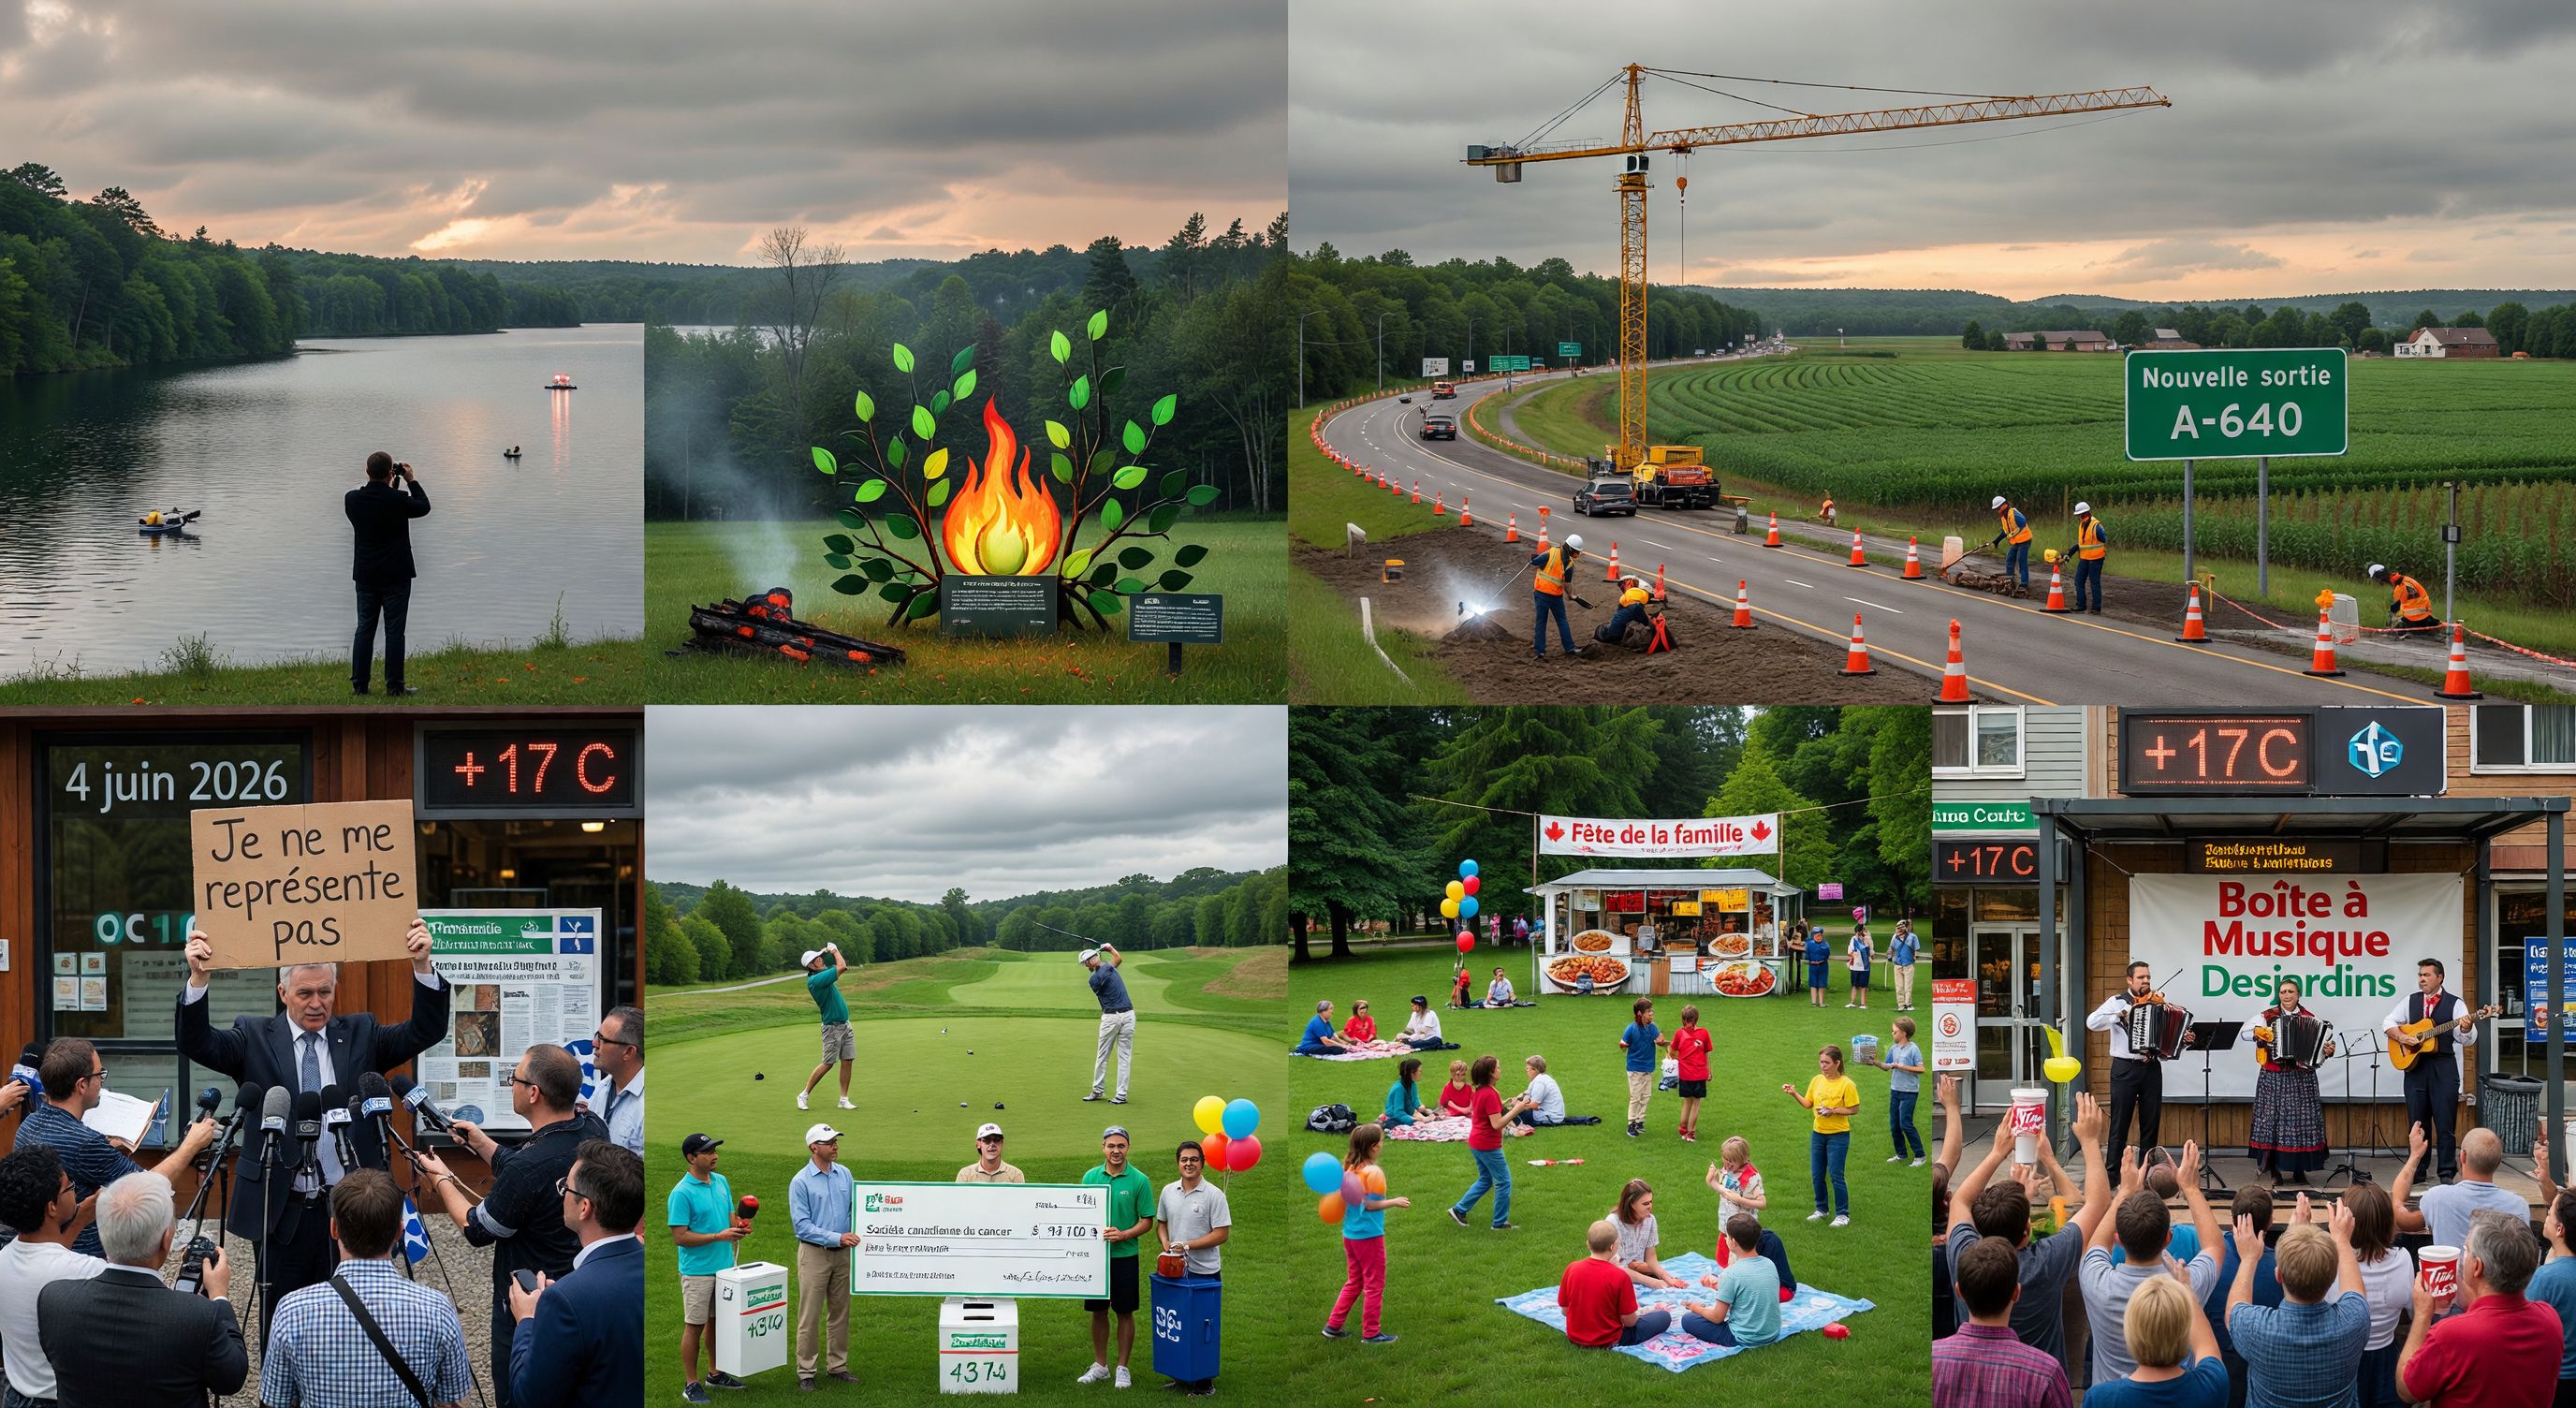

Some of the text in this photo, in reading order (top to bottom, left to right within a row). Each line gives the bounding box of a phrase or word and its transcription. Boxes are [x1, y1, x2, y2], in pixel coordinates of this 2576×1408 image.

[2143, 364, 2331, 389] Nouvelle sortie
[2170, 402, 2303, 440] A-640
[66, 759, 287, 814] 4 juin 2026
[455, 742, 615, 793] +17 C
[212, 817, 394, 862] Je ne me
[1572, 822, 1615, 843] Fête
[1620, 824, 1646, 844] de
[1651, 824, 1669, 844] la
[206, 859, 404, 921] représente
[2218, 879, 2368, 918] Boîte à
[273, 917, 341, 961] pas
[2203, 919, 2391, 967] Musique
[963, 1225, 975, 1236] du
[978, 1227, 1013, 1237] cancer
